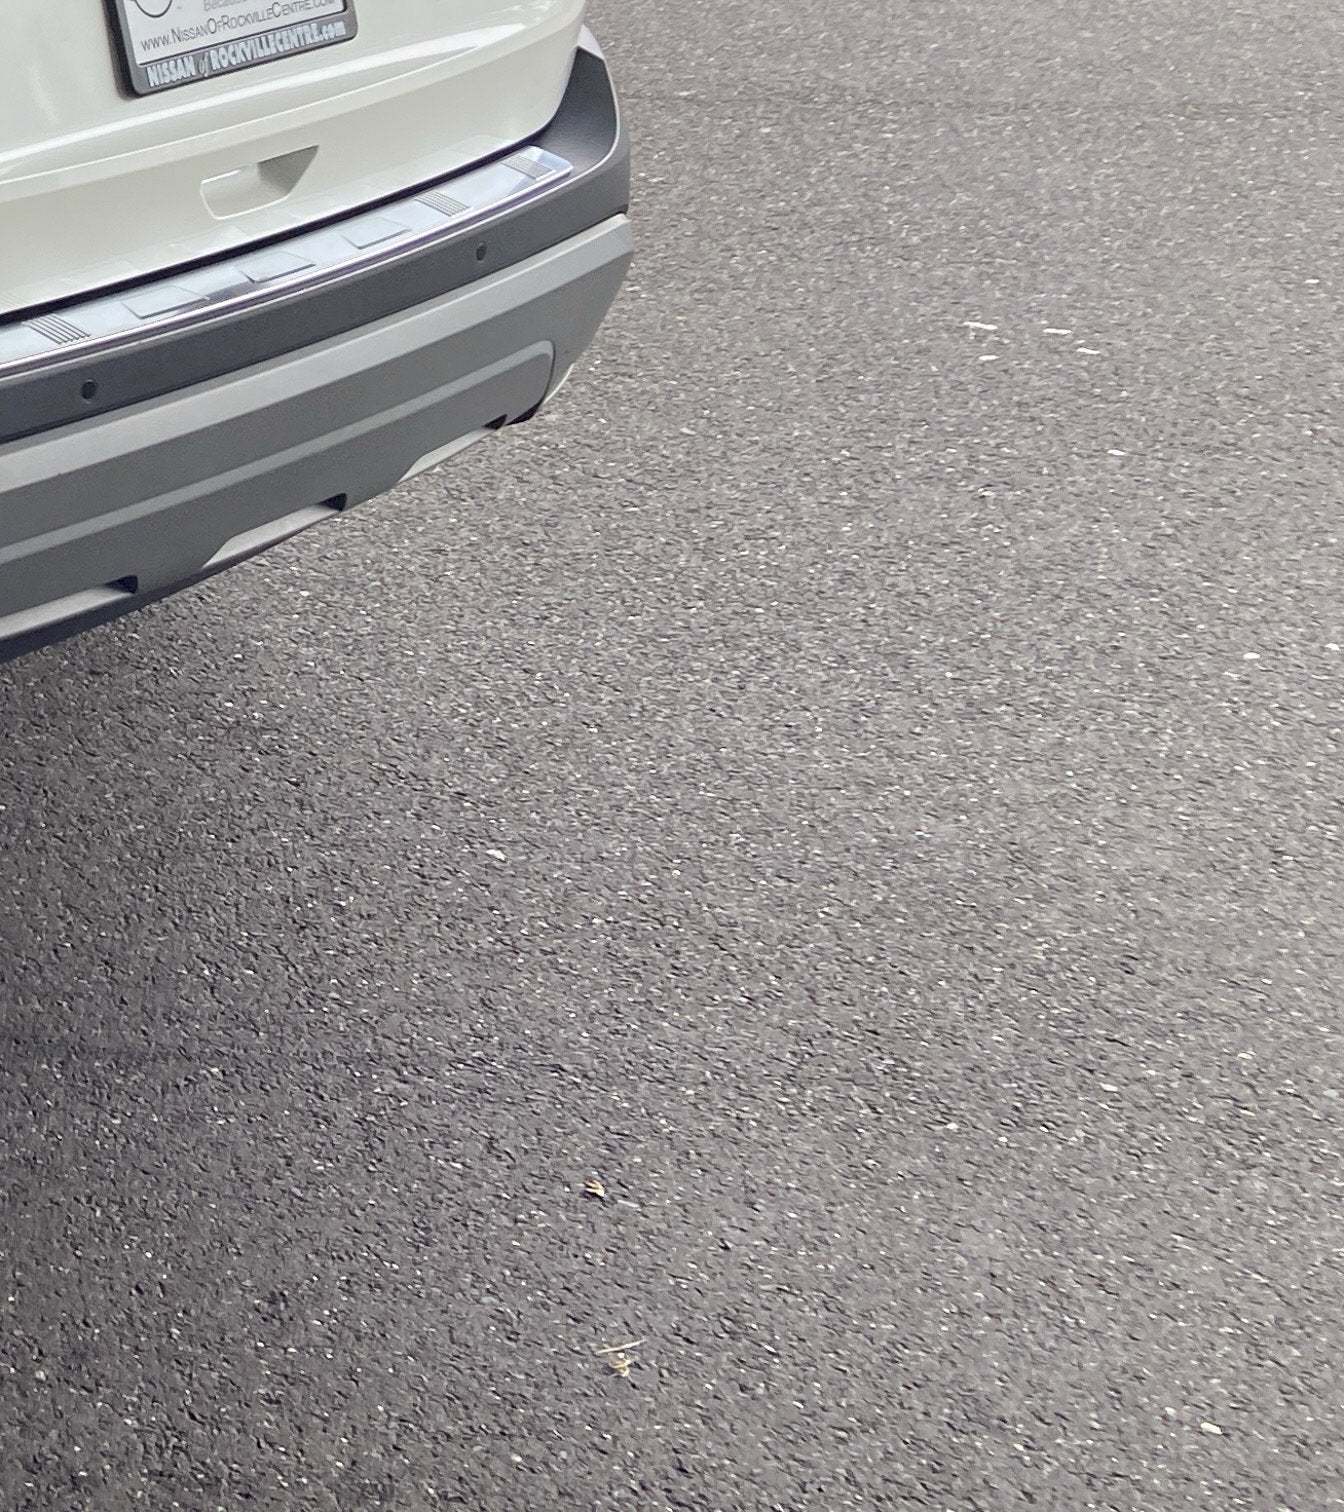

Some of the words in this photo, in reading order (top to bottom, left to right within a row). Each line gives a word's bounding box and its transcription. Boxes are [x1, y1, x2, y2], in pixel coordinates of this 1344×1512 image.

[146, 55, 196, 88] NISSAN
[198, 57, 210, 78] of
[210, 19, 348, 72] ROCKVILLECENTRE.com
